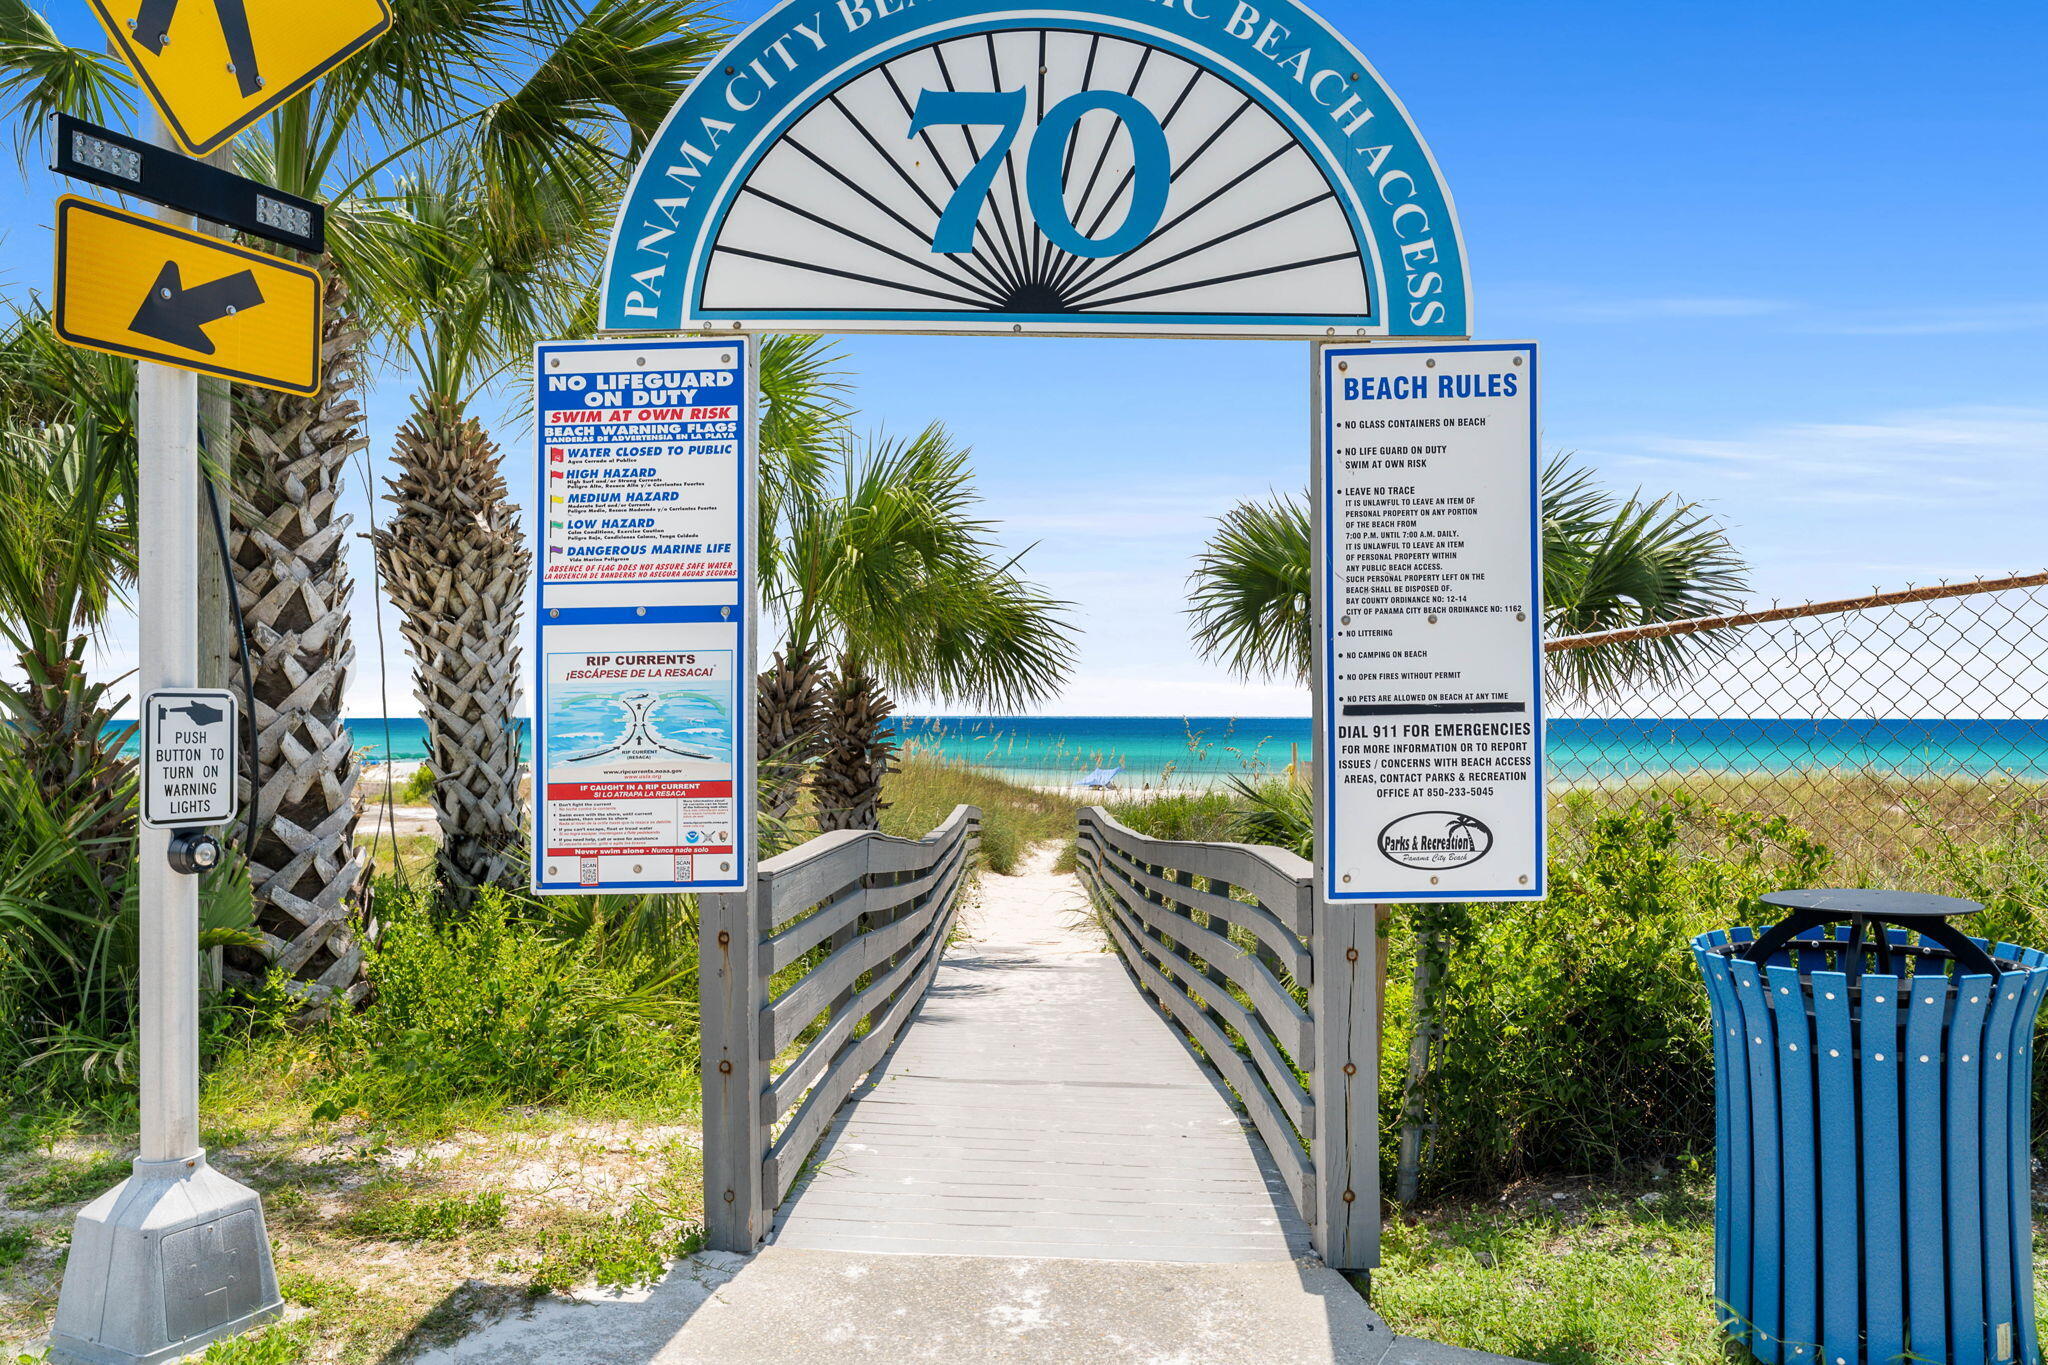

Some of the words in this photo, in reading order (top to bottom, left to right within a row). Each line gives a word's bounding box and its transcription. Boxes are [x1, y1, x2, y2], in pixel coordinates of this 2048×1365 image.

[624, 116, 736, 319] PANAMA
[725, 12, 827, 112] CITY
[1223, 1, 1375, 138] BEACH
[1356, 144, 1446, 327] ACCESS
[907, 84, 1171, 259] 70
[550, 375, 586, 391] NO
[597, 371, 733, 390] LIFEGUARD
[1345, 376, 1426, 400] BEACH
[1439, 373, 1516, 398] RULES
[585, 391, 621, 407] ON
[633, 390, 697, 406] DUTY
[551, 410, 603, 423] SWIM
[609, 410, 632, 421] AT
[637, 408, 684, 421] OWN
[690, 407, 732, 420] RISK
[545, 425, 594, 436] BEACH
[601, 424, 680, 435] WARNING
[688, 423, 736, 433] FLAGS
[1345, 421, 1356, 429] NO
[1359, 420, 1385, 429] GLASS
[1388, 419, 1440, 428] CONTAINERS
[1443, 419, 1454, 427] ON
[1458, 418, 1486, 427] BEACH
[567, 448, 612, 457] WATER
[615, 446, 663, 456] CLOSED
[666, 446, 684, 455] TO
[688, 445, 733, 455] PUBLIC
[1346, 447, 1356, 455] NO
[1360, 447, 1376, 455] LIFE
[1380, 446, 1408, 455] GUARD
[1411, 446, 1422, 454] ON
[1426, 446, 1446, 454] DUTY
[1346, 460, 1369, 469] SWIM
[1372, 460, 1382, 468] AT
[1385, 460, 1404, 468] OWN
[1408, 459, 1426, 468] RISK
[567, 469, 598, 478] HIGH
[604, 468, 656, 478] HAZARD
[568, 493, 622, 502] MEDIUM
[626, 492, 679, 501] HAZARD
[1346, 487, 1370, 496] LEAVE
[1375, 487, 1384, 495] NO
[1389, 486, 1414, 495] TRACE
[567, 519, 598, 529] LOW
[601, 518, 655, 528] HAZARD
[567, 545, 647, 556] DANGEROUS
[651, 544, 702, 554] MARINE
[706, 544, 732, 553] LIFE
[707, 562, 733, 570] WATER
[1405, 650, 1427, 658] BEACH
[587, 656, 610, 666] RIP
[616, 655, 695, 665] CURRENTS
[566, 669, 628, 681] ¡ESCÁPESE
[630, 668, 646, 679] DE
[648, 668, 663, 679] LA
[1435, 671, 1460, 679] PERMIT
[1339, 726, 1368, 739] DIAL
[1373, 725, 1396, 738] 911
[1404, 724, 1429, 738] FOR
[1435, 722, 1530, 737] EMERGENCIES
[176, 732, 206, 744] PUSH
[1342, 745, 1360, 754] FOR
[1364, 744, 1390, 754] MORE
[1394, 743, 1457, 753] INFORMATION
[1461, 743, 1473, 752] OR
[1476, 742, 1487, 752] TO
[1491, 742, 1527, 752] REPORT
[156, 749, 200, 762] BUTTON
[211, 748, 224, 761] TO
[163, 767, 193, 779] TURN
[203, 765, 218, 777] ON
[1344, 774, 1376, 784] AREAS,
[1380, 773, 1422, 784] CONTACT
[1426, 773, 1455, 783] PARKS
[1459, 772, 1465, 782] &
[1469, 771, 1526, 782] RECREATION
[164, 783, 217, 796] WARNING
[1377, 788, 1409, 798] OFFICE
[1413, 788, 1423, 797] AT
[1428, 787, 1493, 797] 850-233-5045
[170, 800, 210, 814] LIGHTS
[1385, 836, 1409, 851] Parks
[1412, 836, 1417, 850] &
[1421, 836, 1468, 850] Recreation
[1403, 854, 1429, 862] Panama
[1432, 853, 1446, 862] City
[1448, 853, 1467, 861] Beach
